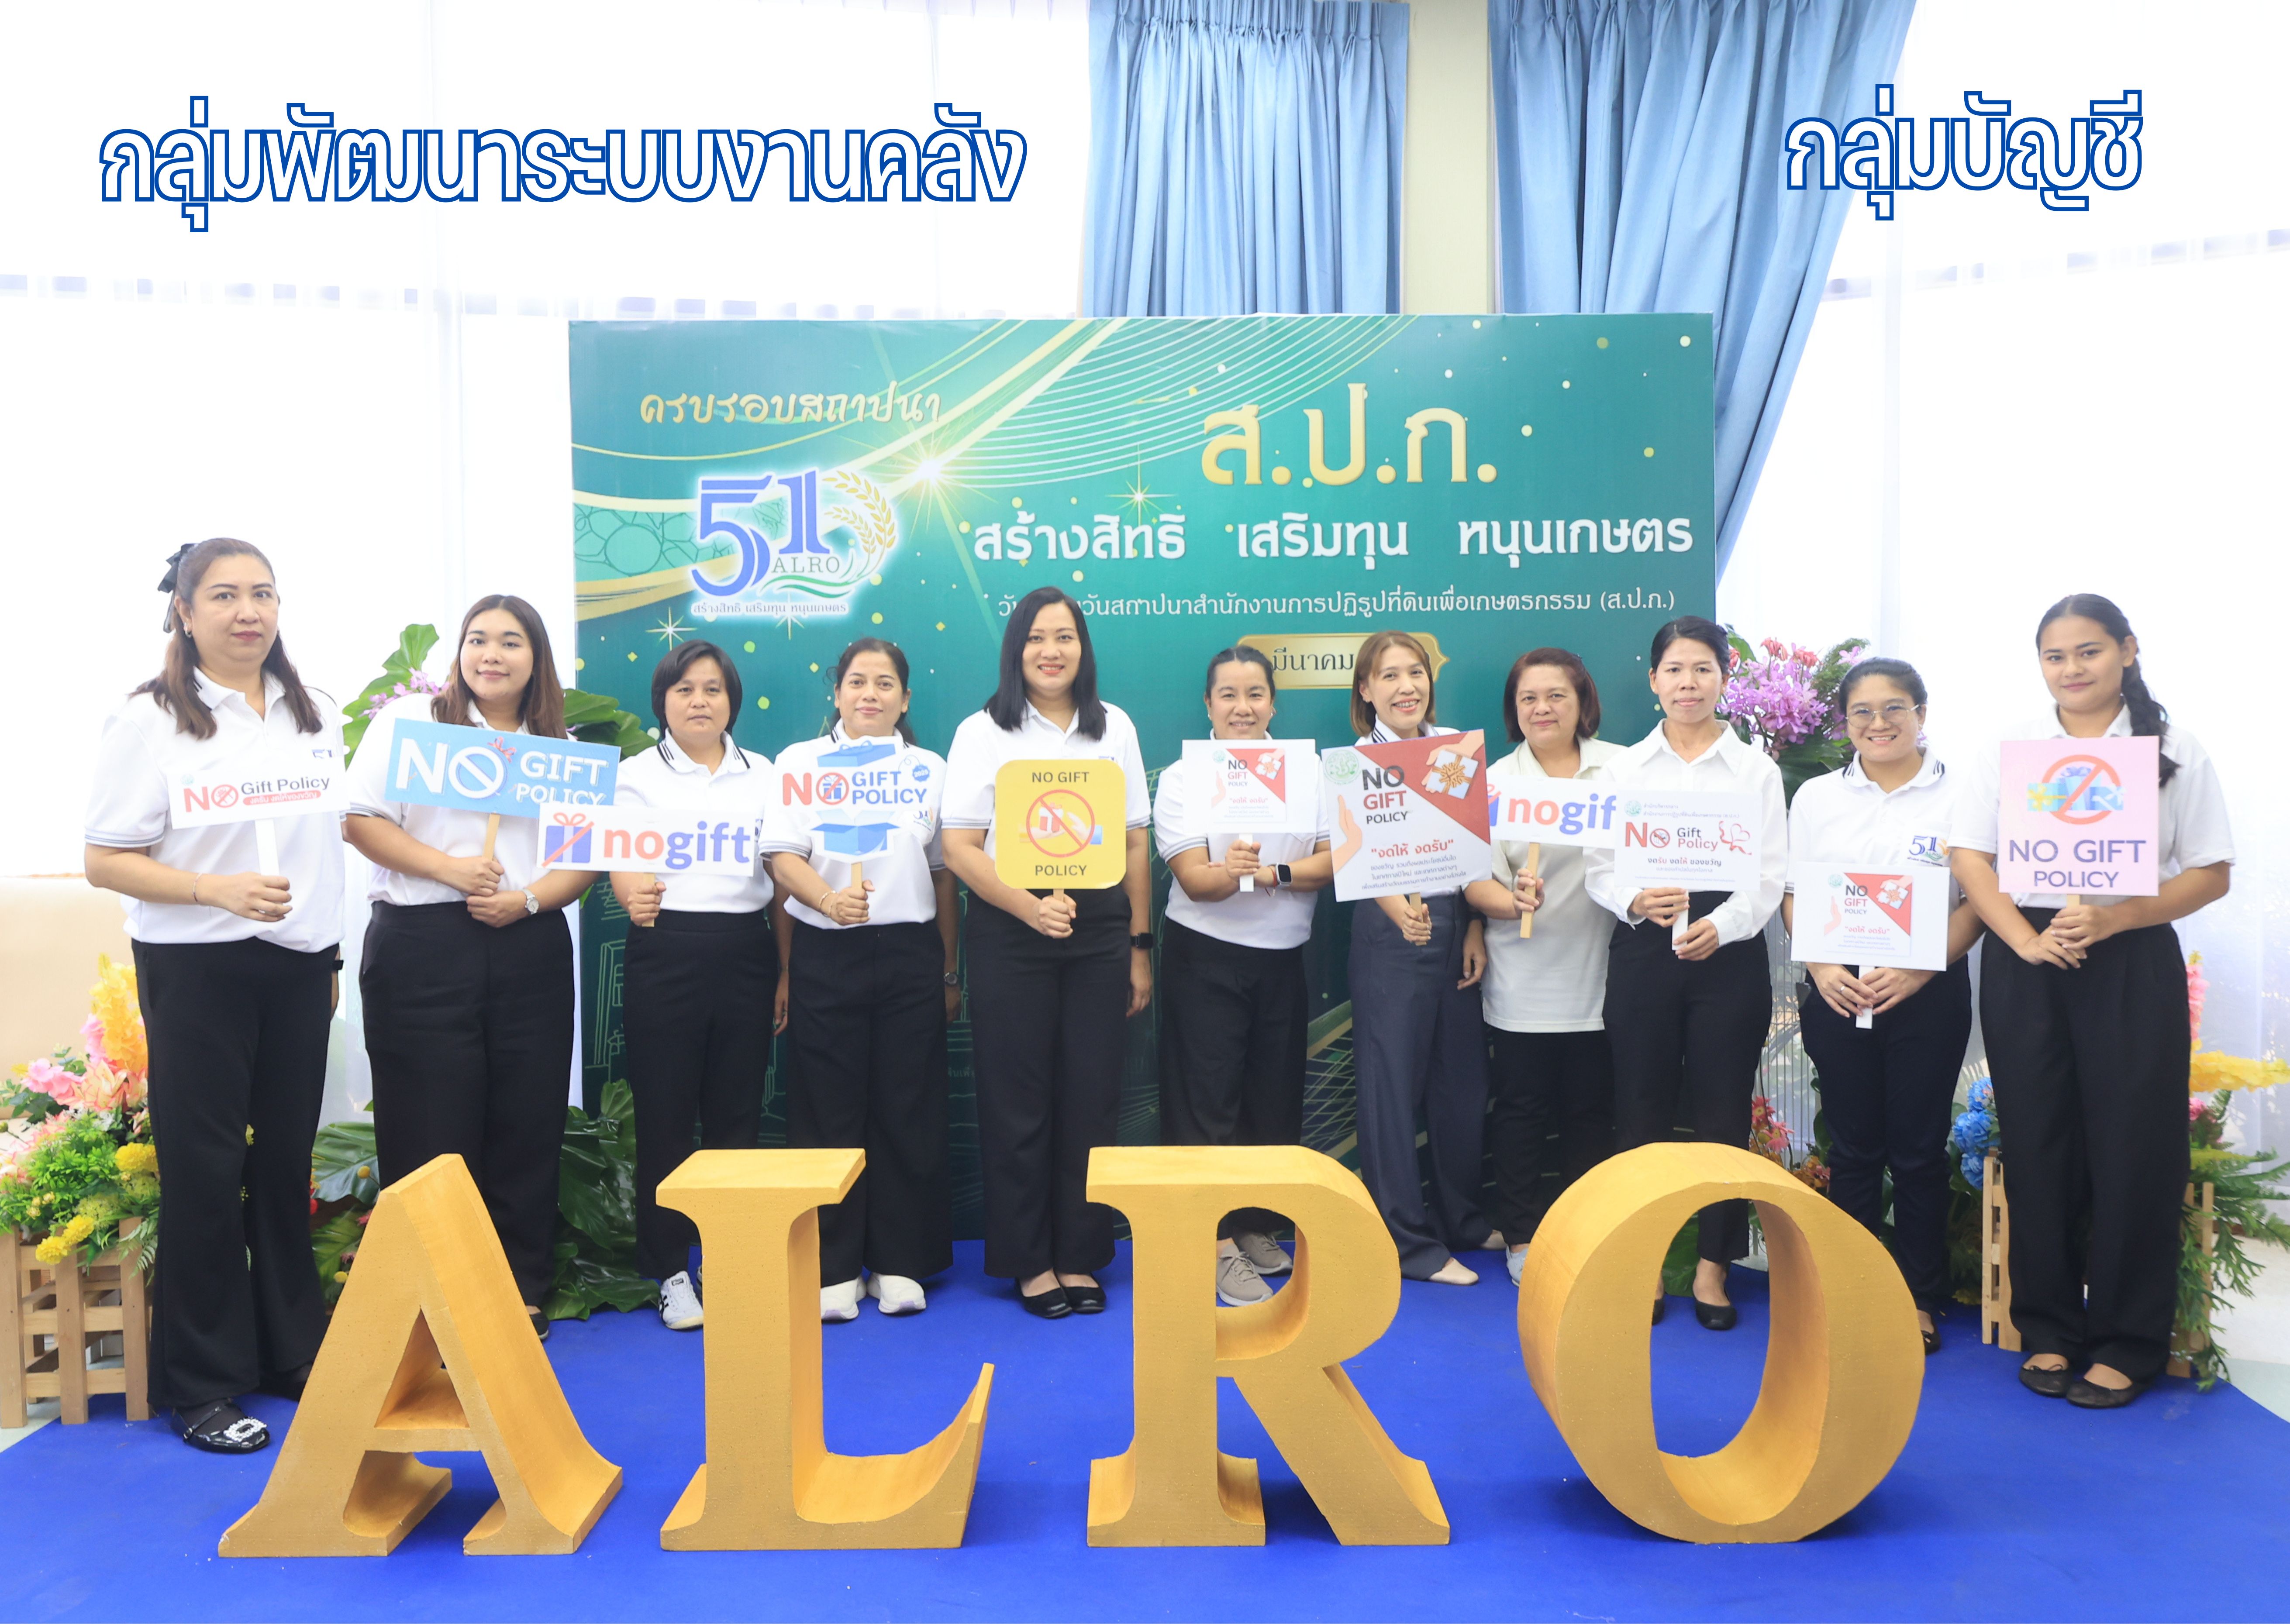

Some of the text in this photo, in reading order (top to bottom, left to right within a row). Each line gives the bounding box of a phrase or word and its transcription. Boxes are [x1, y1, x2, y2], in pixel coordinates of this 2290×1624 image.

[640, 381, 942, 423] ครบรอบสถาปนา
[1201, 382, 1498, 485] ส.ป.ก.
[691, 470, 830, 596] 51
[973, 510, 1693, 570] สร้างสิทธิ เสริมทุน หนุนเกษตร
[771, 557, 840, 573] ALRO
[1073, 585, 1591, 618] วันสถาปนาสำนักงานการปฏิรูปที่ดินเพื่อเกษตรกรรม
[1272, 647, 1354, 671] มีนาคม
[520, 751, 609, 786] GIFT
[1228, 759, 1248, 770] NO
[241, 780, 273, 795] Gift
[277, 776, 330, 791] Policy
[852, 771, 901, 787] GIFT
[1031, 771, 1090, 783] NO GIFT
[1228, 771, 1248, 780] GIFT
[1362, 765, 1404, 791] NO
[516, 783, 607, 805] POLICY
[852, 788, 928, 805] POLICY
[1363, 790, 1407, 811] GIFT
[1366, 811, 1408, 825] POLICY
[1507, 793, 1617, 835] nogif
[1677, 827, 1701, 838] Gift
[604, 820, 750, 870] nogift
[1678, 838, 1718, 852] Policy
[1909, 835, 1937, 856] 51
[2010, 839, 2146, 863] NO GIFT
[1035, 864, 1087, 876] POLICY
[2034, 870, 2119, 888] POLICY
[1845, 885, 1868, 897] NO
[1845, 898, 1868, 907] GIFT
[217, 1140, 1927, 1558] ALRO
